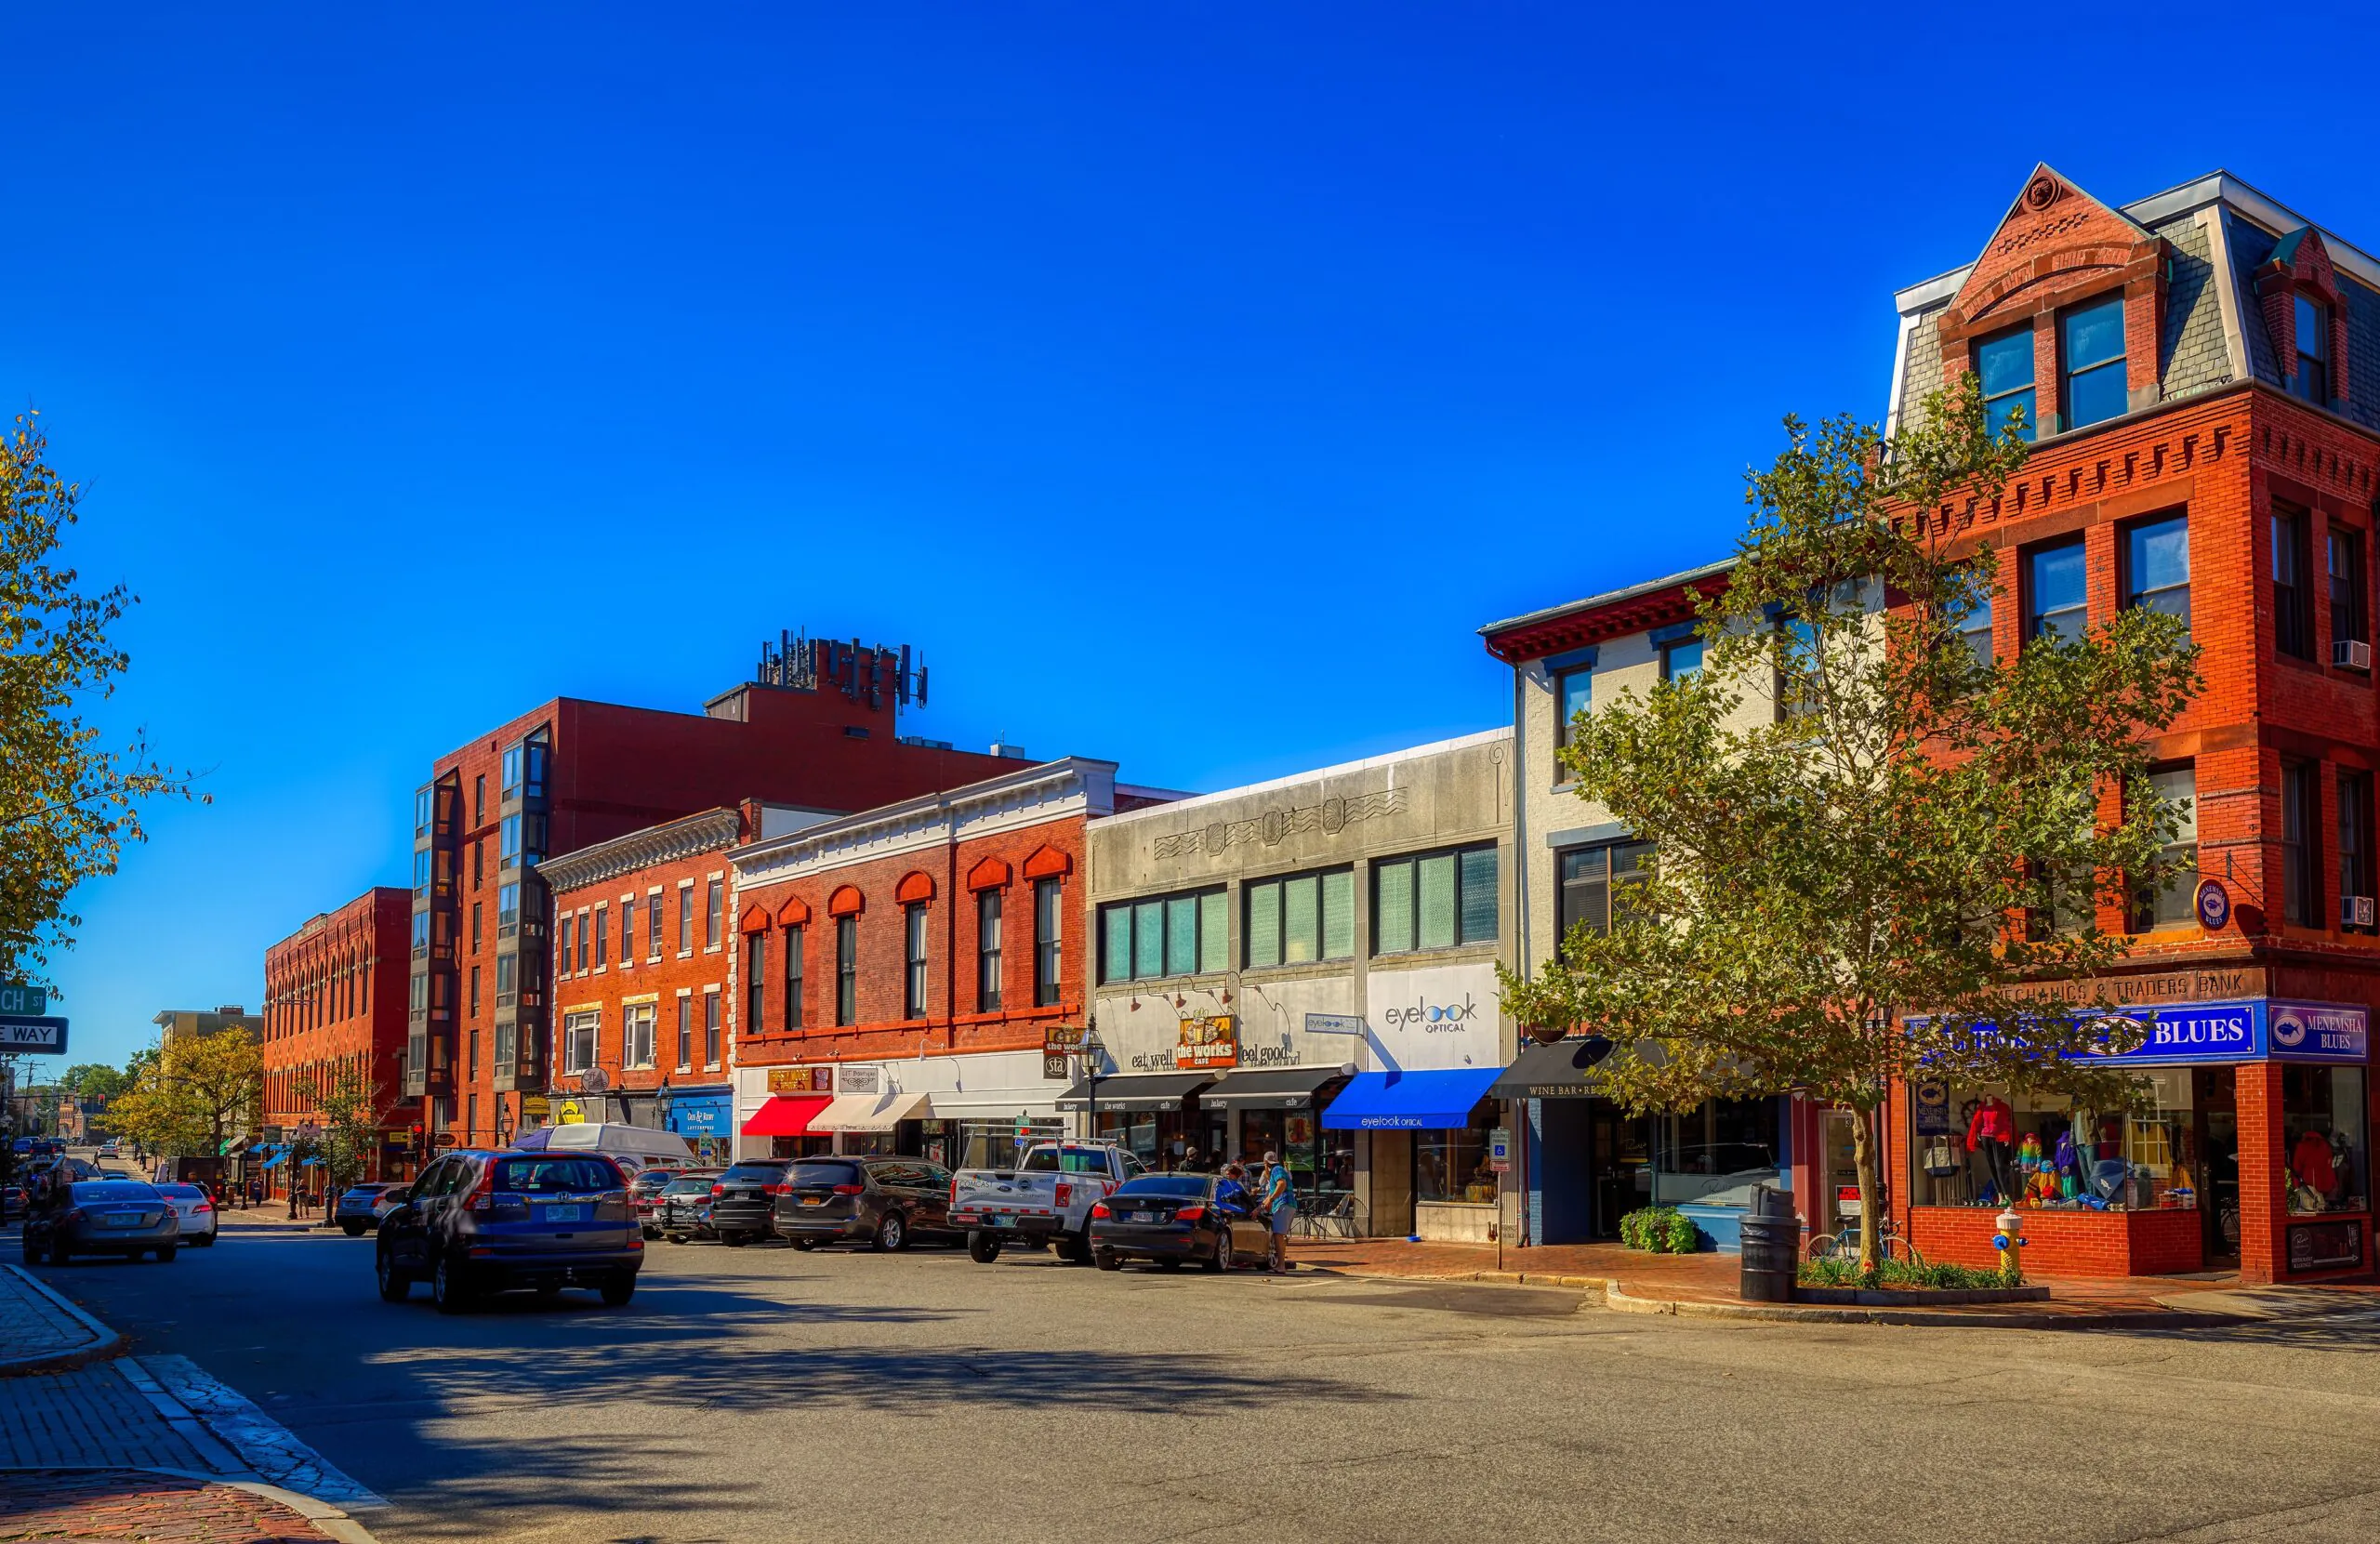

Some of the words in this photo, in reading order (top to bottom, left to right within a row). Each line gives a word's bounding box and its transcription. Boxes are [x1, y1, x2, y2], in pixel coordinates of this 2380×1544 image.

[2206, 916, 2223, 925] BLUES
[2097, 984, 2106, 996] &
[2114, 979, 2187, 997] TRADERS
[2199, 974, 2241, 992] BANK
[33, 996, 44, 1007] ST
[1385, 992, 1477, 1032] eyelook
[1425, 1023, 1465, 1033] OPTICAL
[2154, 1017, 2244, 1044] BLUES
[2307, 1015, 2362, 1032] MENEMSHA
[13, 1026, 51, 1041] WAY
[1047, 1042, 1062, 1050] the
[2320, 1034, 2350, 1049] BLUES
[1177, 1044, 1193, 1059] the
[1194, 1042, 1233, 1058] works
[1260, 1041, 1288, 1065] good
[1050, 1058, 1064, 1072] sta
[1131, 1051, 1147, 1068] eat
[1150, 1049, 1172, 1066] well
[1529, 1086, 1555, 1095] WINE
[1558, 1086, 1578, 1095] BAR
[1063, 1102, 1078, 1111] bakery
[1160, 1101, 1170, 1110] cafe
[1210, 1099, 1227, 1109] bakery
[1286, 1098, 1298, 1106] cafe
[1361, 1115, 1399, 1128] eyelook
[1400, 1118, 1422, 1127] OPTICAL
